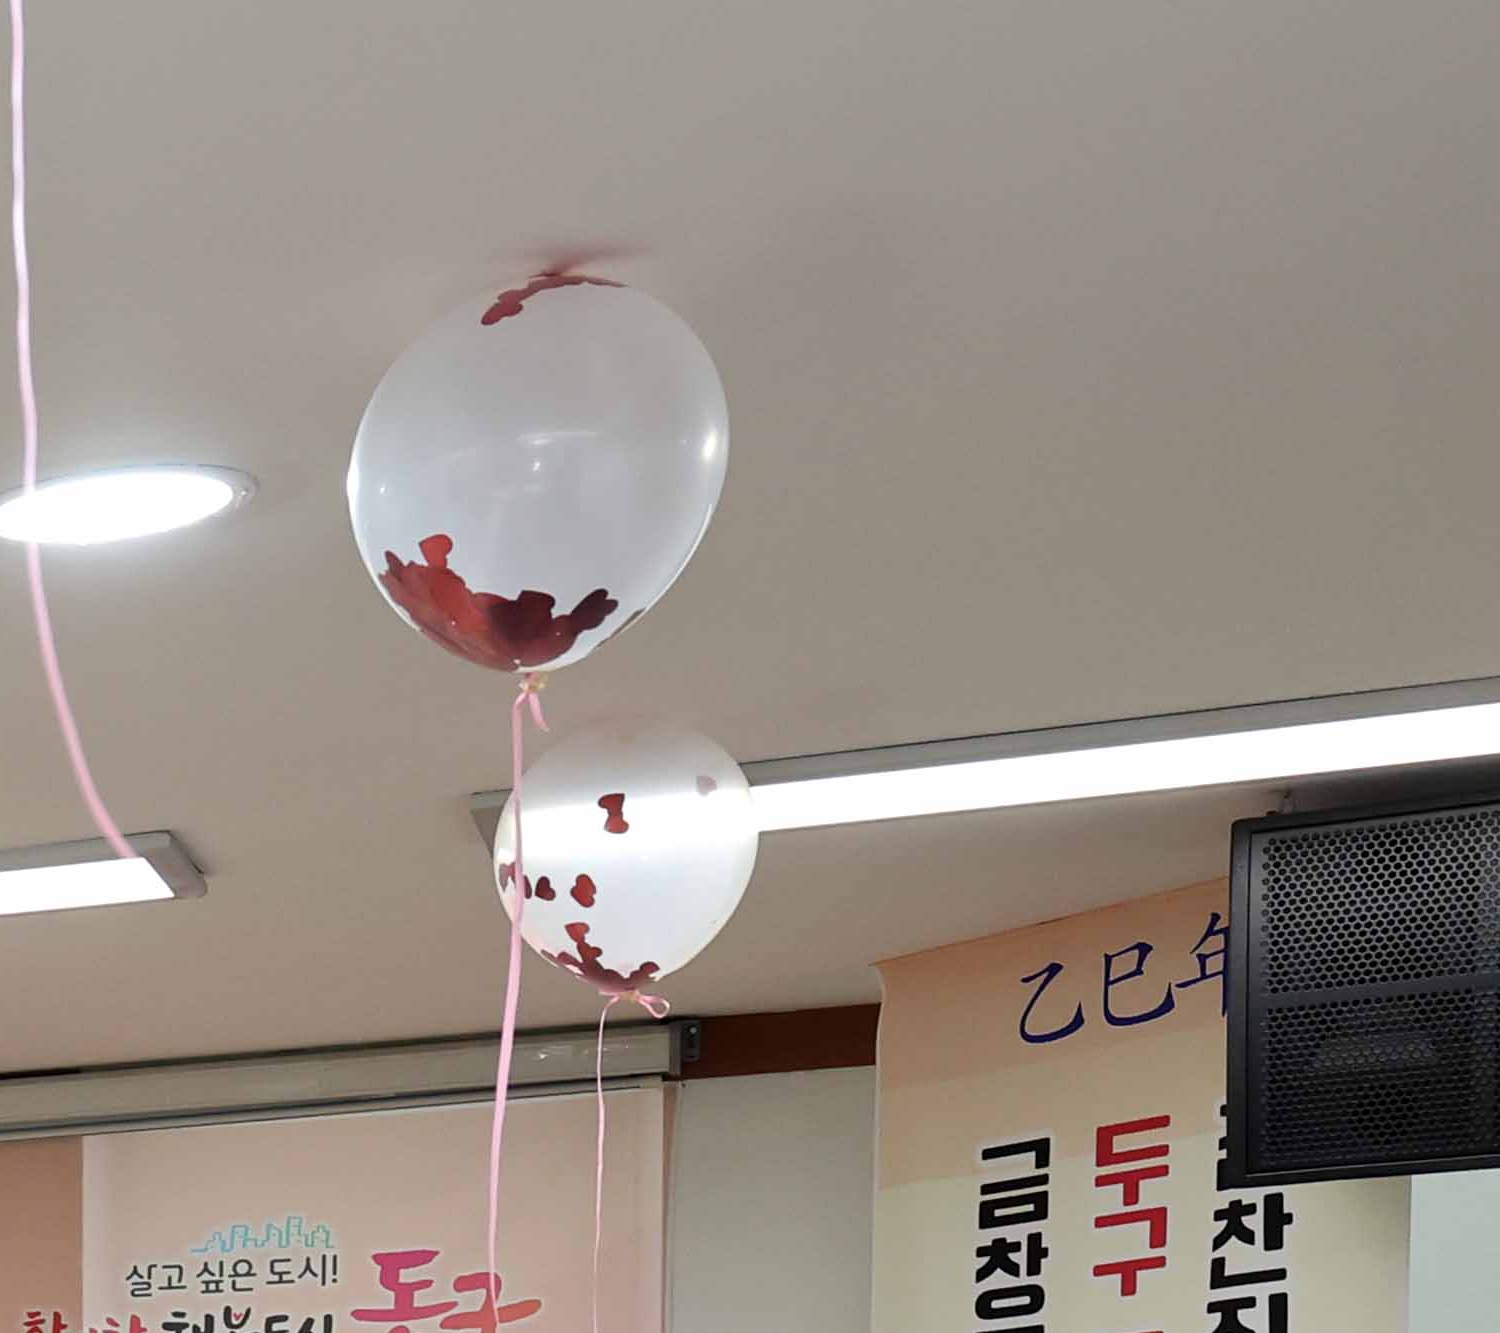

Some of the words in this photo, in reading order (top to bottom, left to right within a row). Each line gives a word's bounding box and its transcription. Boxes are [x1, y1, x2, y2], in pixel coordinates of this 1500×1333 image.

[1093, 1114, 1171, 1297] 두구
[125, 1263, 187, 1298] 살고
[197, 1260, 258, 1294] 싶은
[267, 1254, 339, 1289] 도시!
